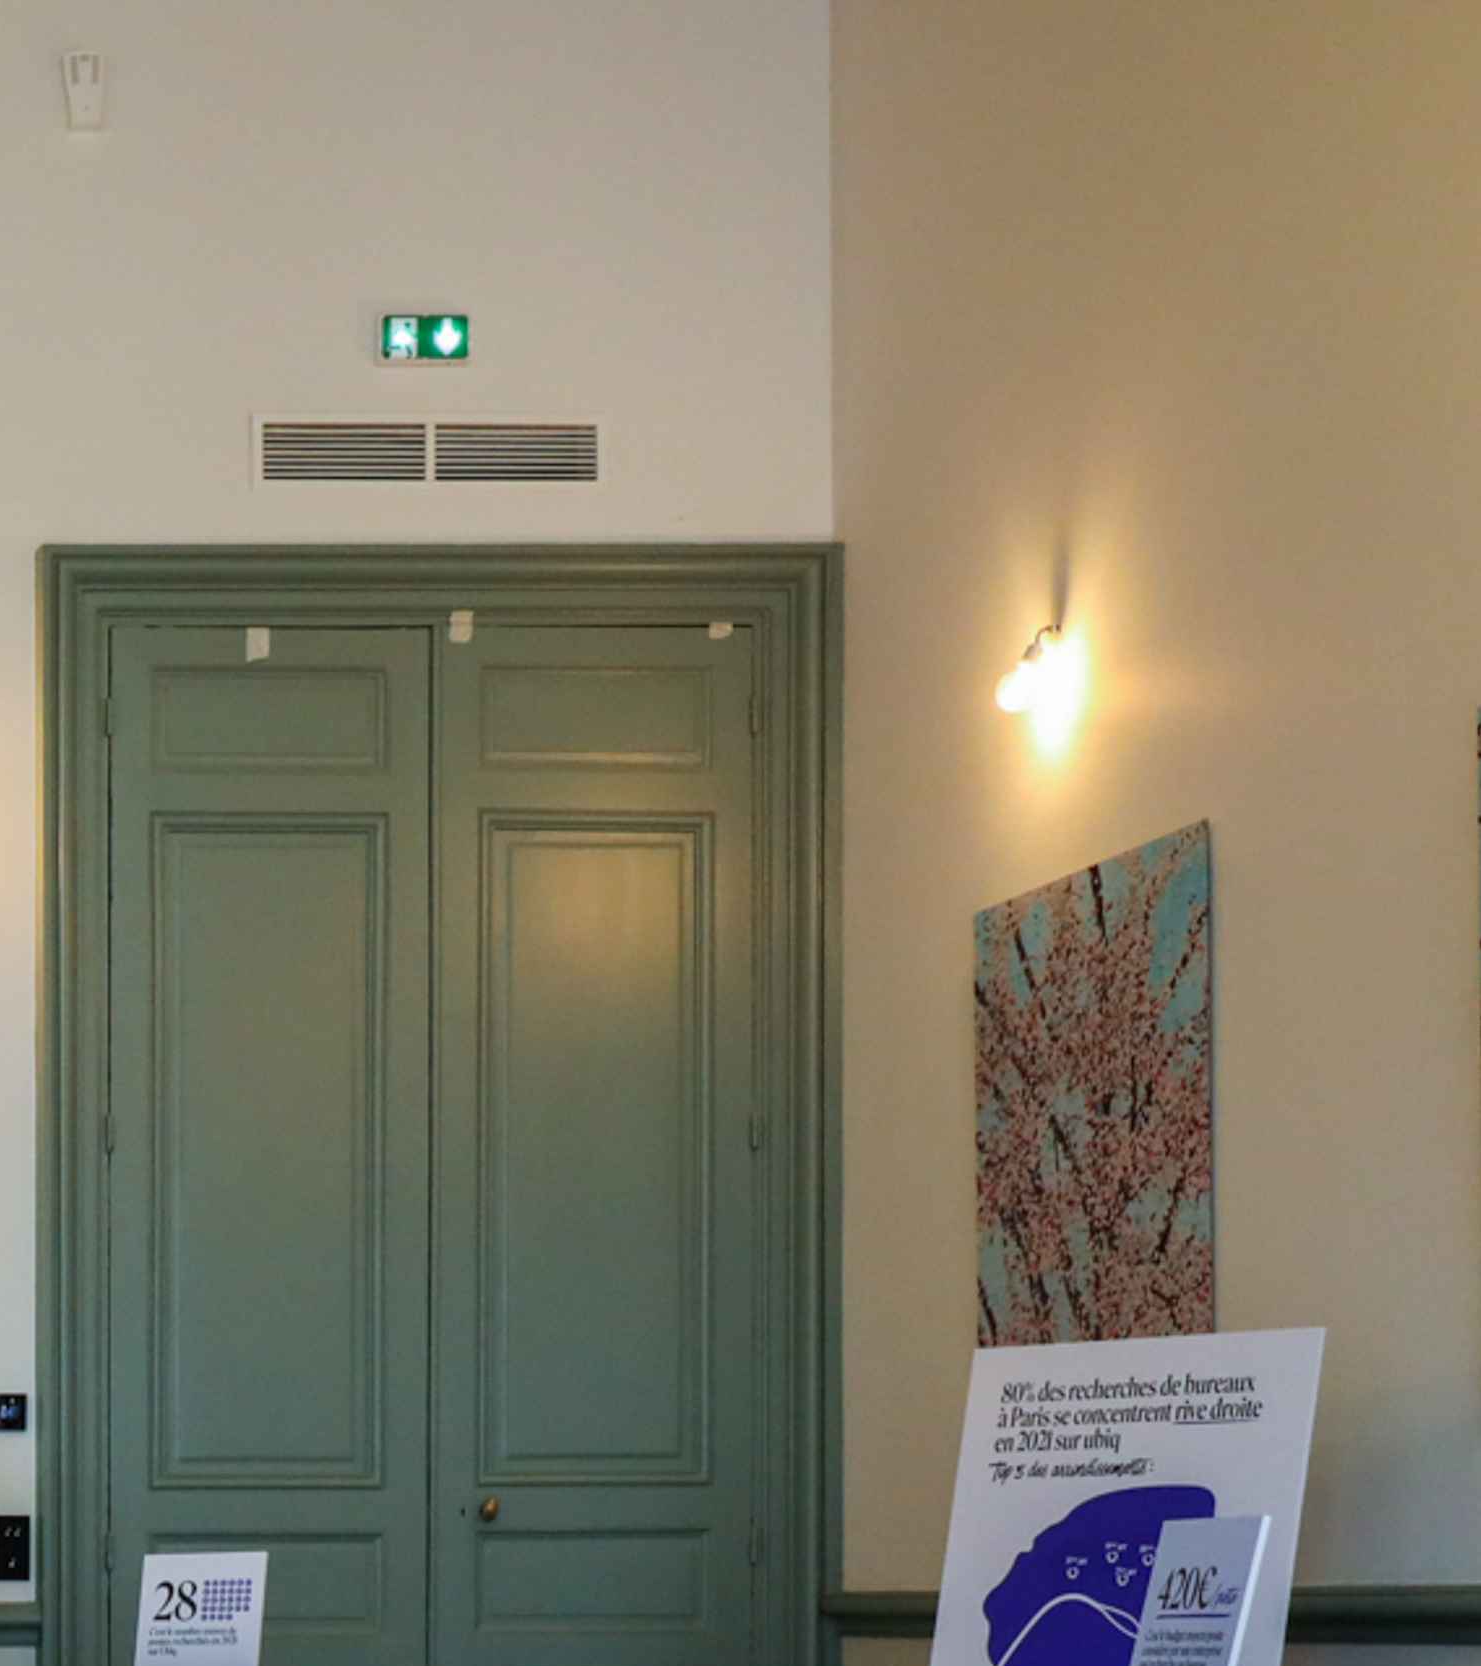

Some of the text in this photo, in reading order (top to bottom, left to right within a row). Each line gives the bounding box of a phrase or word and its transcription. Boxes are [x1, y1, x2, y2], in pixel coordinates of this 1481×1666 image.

[1000, 1372, 1255, 1403] 80% des recherches de bureaux
[1009, 1406, 1051, 1428] Paris
[1053, 1410, 1071, 1427] se
[1074, 1404, 1172, 1425] concentrent
[1175, 1399, 1208, 1421] rive
[1209, 1397, 1263, 1420] droite
[994, 1427, 1121, 1454] en 2021 sur ubiq
[153, 1579, 198, 1622] 28
[1157, 1566, 1218, 1610] 420€
